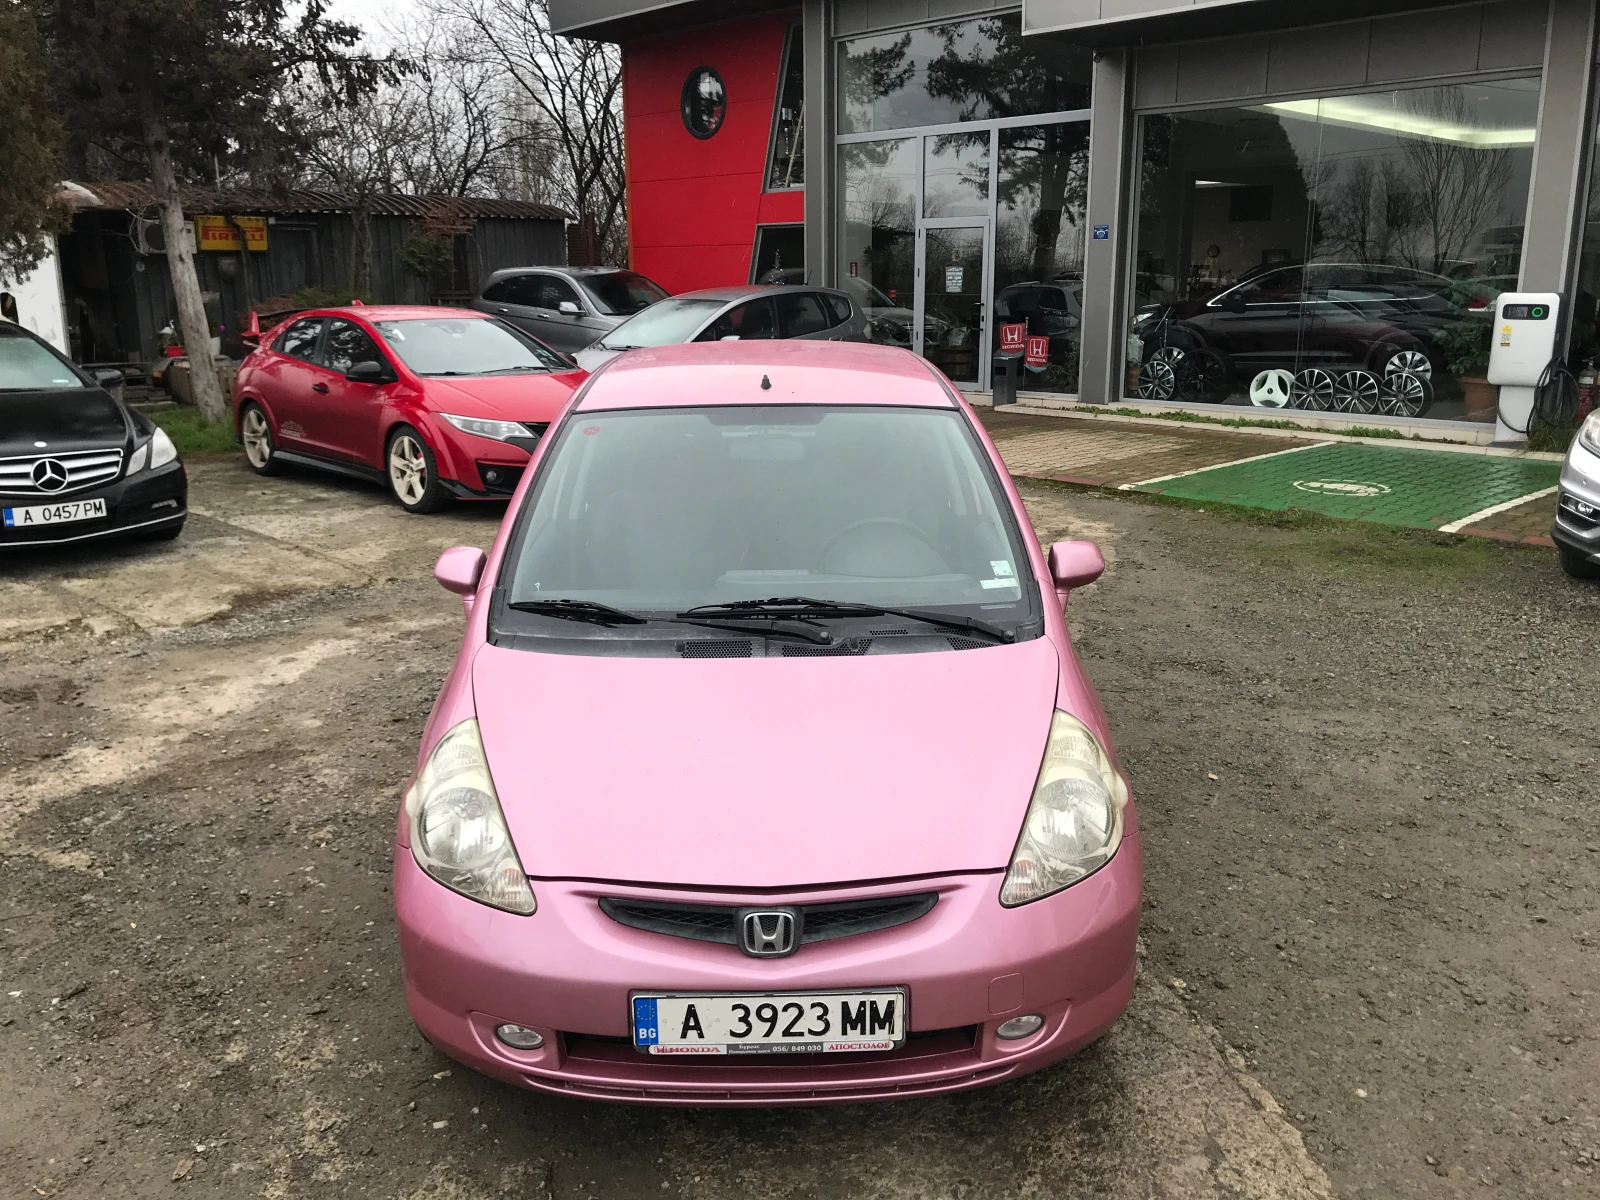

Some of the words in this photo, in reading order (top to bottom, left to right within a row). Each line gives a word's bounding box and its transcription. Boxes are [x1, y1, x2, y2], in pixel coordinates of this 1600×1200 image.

[24, 509, 34, 523] A
[42, 504, 80, 521] 0457
[83, 501, 103, 516] PM
[680, 1003, 705, 1039] A
[729, 1001, 831, 1038] 3923
[841, 999, 895, 1036] MM
[639, 1028, 656, 1039] BG
